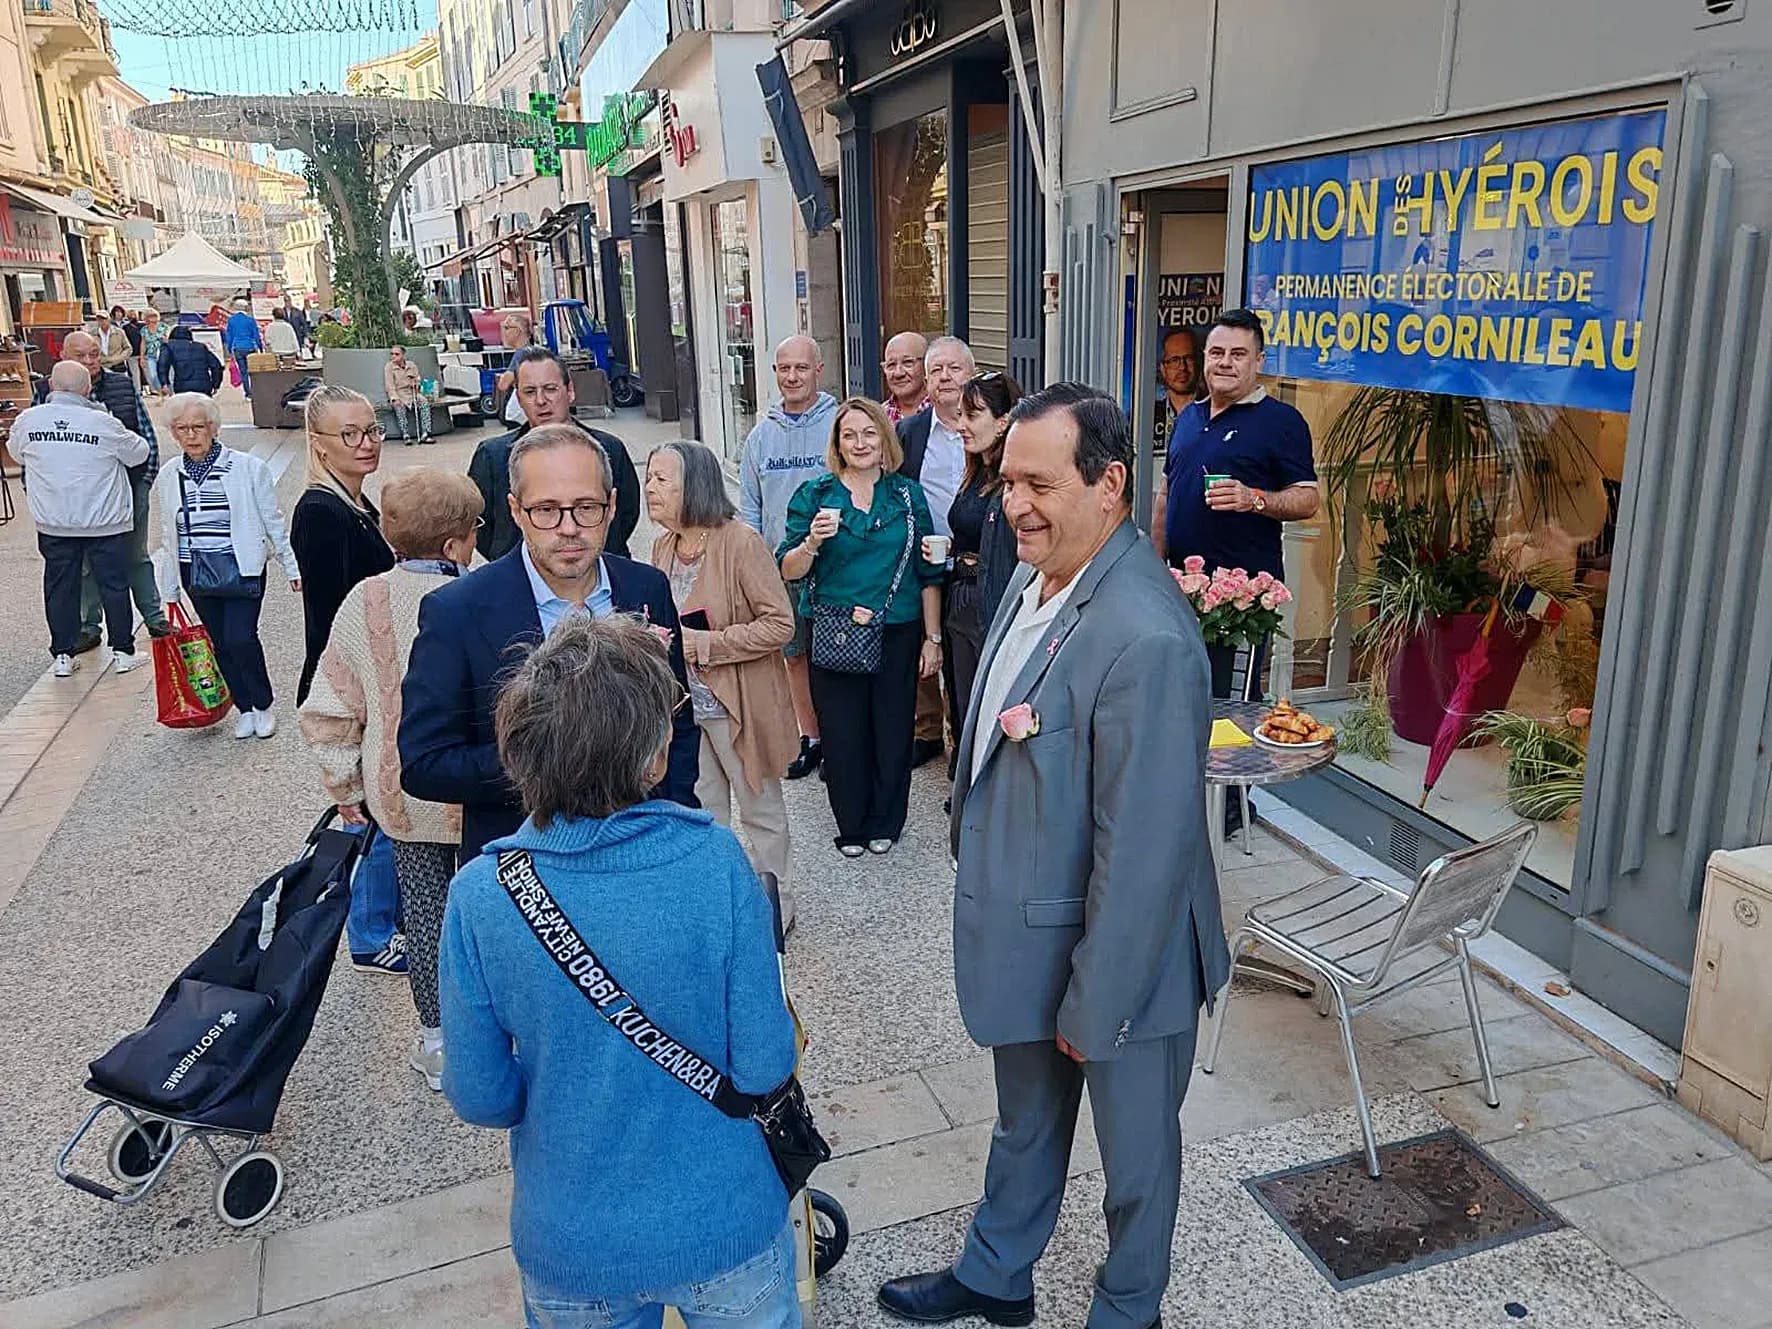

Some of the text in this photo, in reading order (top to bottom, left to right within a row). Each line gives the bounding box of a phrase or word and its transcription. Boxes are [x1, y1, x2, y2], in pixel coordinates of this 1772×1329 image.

[1249, 176, 1379, 243] UNION
[1393, 174, 1413, 237] DES
[1408, 141, 1664, 234] HYÉROIS
[1275, 266, 1594, 303] PERMANENCE ÉLECTORALE DE
[1254, 308, 1643, 371] RANÇOIS CORNILEAU
[28, 431, 100, 446] ROYALWEAR
[502, 866, 572, 962] CITYANDLIFE
[161, 1024, 225, 1091] ISOTHERME
[609, 1004, 721, 1101] KUCHEN&BA
